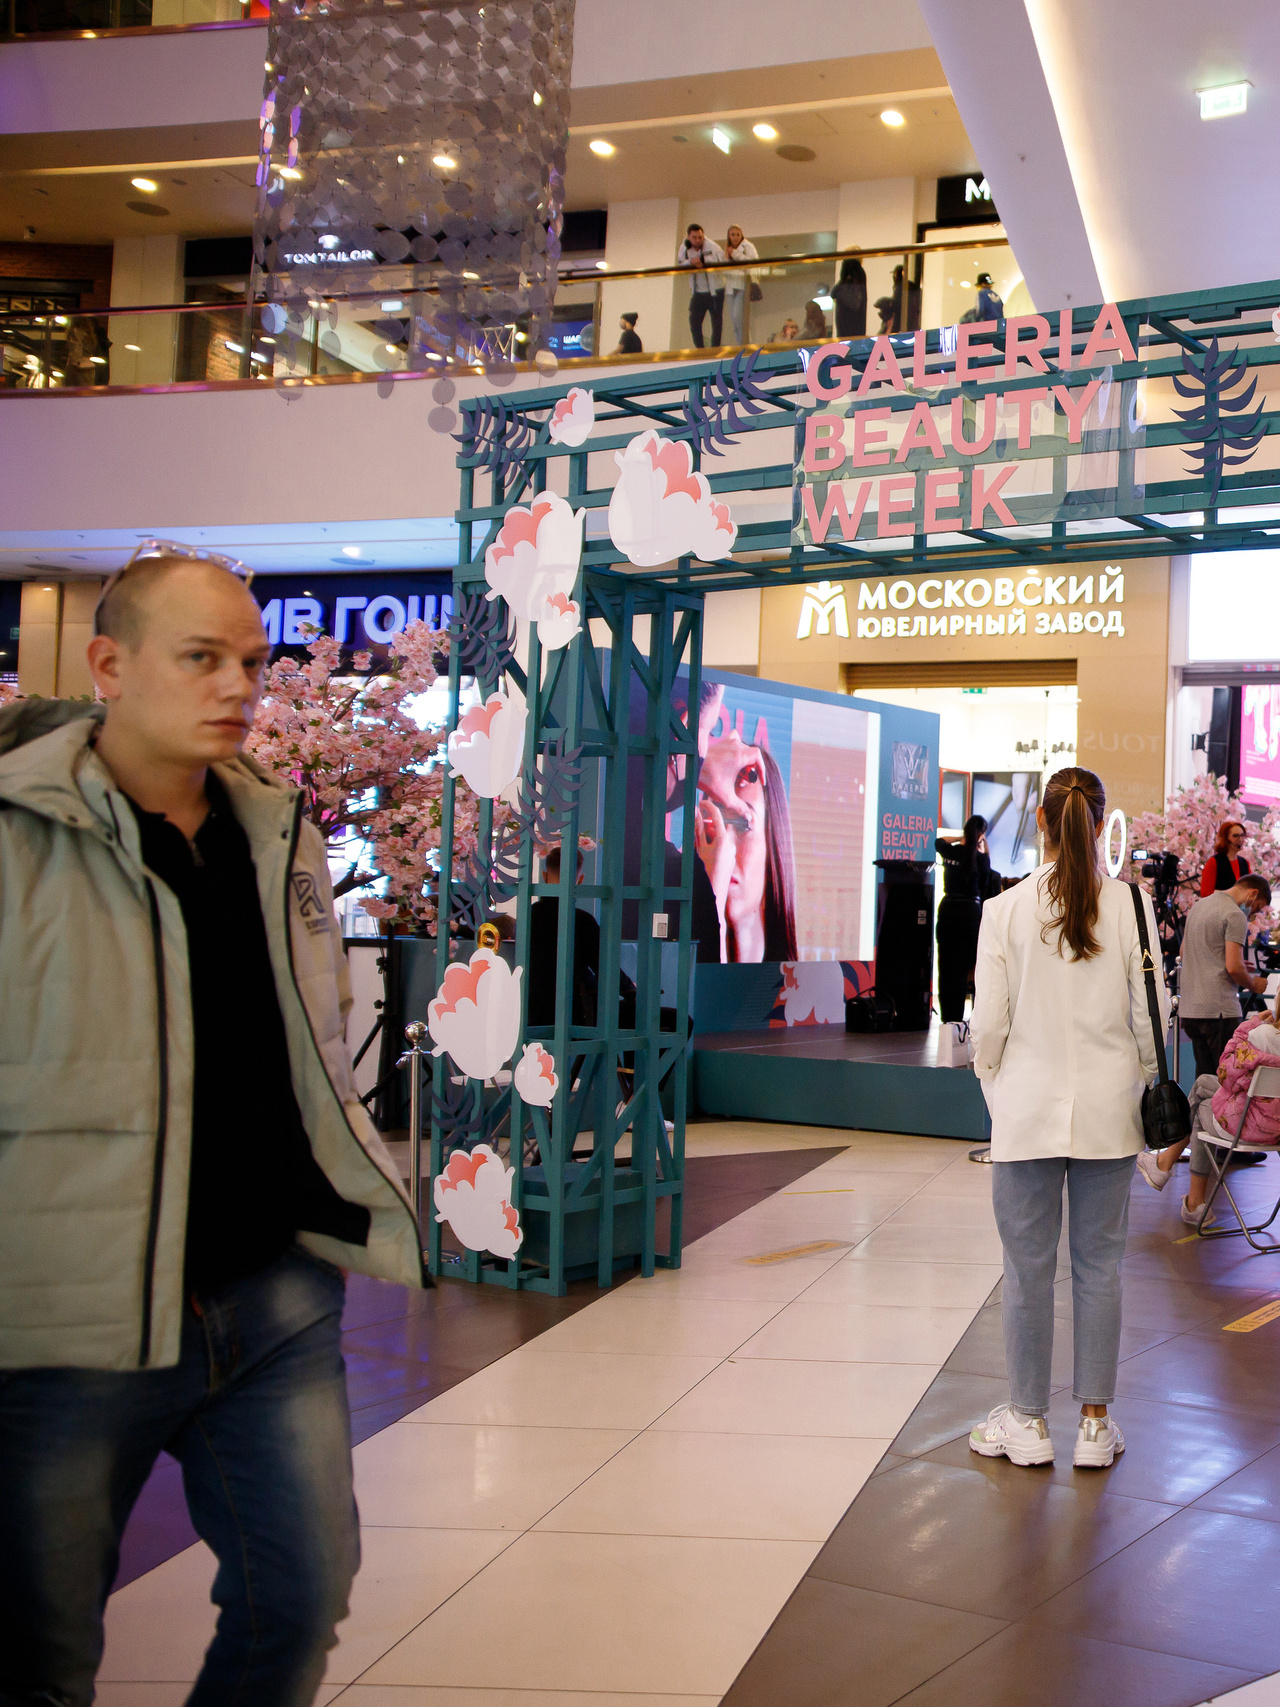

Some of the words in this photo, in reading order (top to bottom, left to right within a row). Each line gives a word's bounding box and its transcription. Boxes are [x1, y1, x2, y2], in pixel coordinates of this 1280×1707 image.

[805, 302, 1137, 401] GALERIA
[804, 380, 1104, 473] BEAUTY
[800, 465, 1020, 545] WEEK
[857, 565, 1126, 611] МОСКОВСКИЙ
[261, 597, 324, 645] ИВ
[857, 608, 1027, 639] ЮВЕЛИРНЫЙ
[1035, 610, 1126, 638] ЗАВОД
[882, 813, 934, 832] GALERIA
[882, 831, 929, 849] BEAUTY
